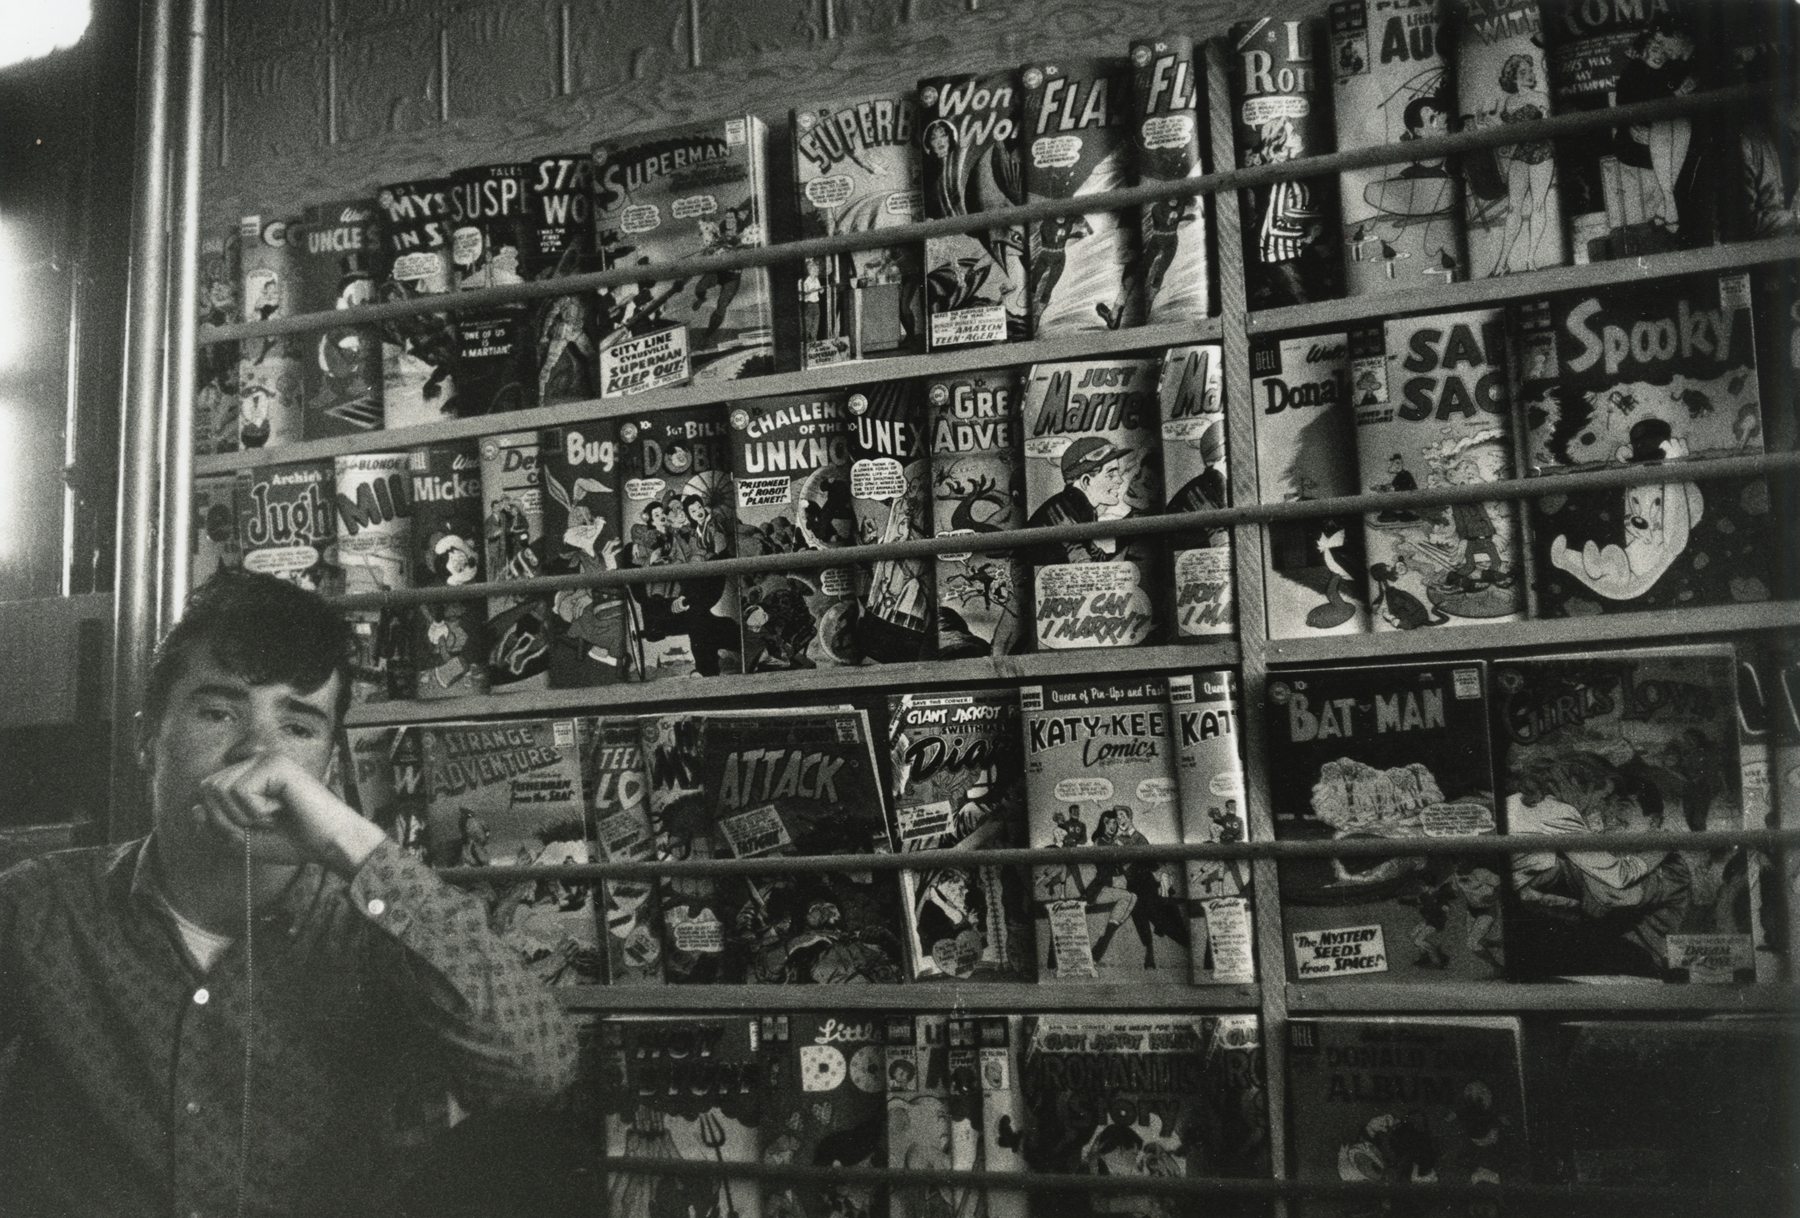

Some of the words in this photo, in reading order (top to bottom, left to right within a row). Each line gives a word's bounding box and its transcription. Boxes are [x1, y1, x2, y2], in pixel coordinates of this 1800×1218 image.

[602, 143, 732, 213] SUPERMAN
[308, 227, 362, 254] UNCLE
[610, 342, 640, 358] CITY
[644, 331, 672, 349] LINE
[1565, 297, 1737, 375] Spooky
[609, 347, 682, 379] SUPERMAN
[1254, 349, 1276, 371] DELL
[606, 369, 651, 394] KEEP
[653, 355, 687, 378] OUT!
[1078, 366, 1137, 388] JUST
[954, 385, 1010, 419] GRE
[799, 424, 816, 435] OF
[933, 418, 1011, 453] ADVE
[566, 431, 615, 472] Bug
[742, 489, 754, 498] of
[755, 486, 788, 497] ROBOT
[1089, 592, 1134, 616] CAN
[1040, 619, 1055, 639] I
[1051, 690, 1078, 704] Queen
[1078, 689, 1089, 704] of
[1090, 686, 1125, 702] Pin-Ups
[1126, 686, 1143, 698] and
[906, 708, 948, 724] GIANT
[951, 705, 1002, 724] JACKPOT
[1288, 687, 1445, 742] BAT-MAN
[444, 727, 534, 754] STRANGE
[430, 745, 562, 798] ADVENTURES
[719, 747, 845, 810] ATTACK
[1319, 929, 1378, 945] MYSTERY
[1312, 944, 1362, 959] SEEDS
[1300, 961, 1330, 974] from
